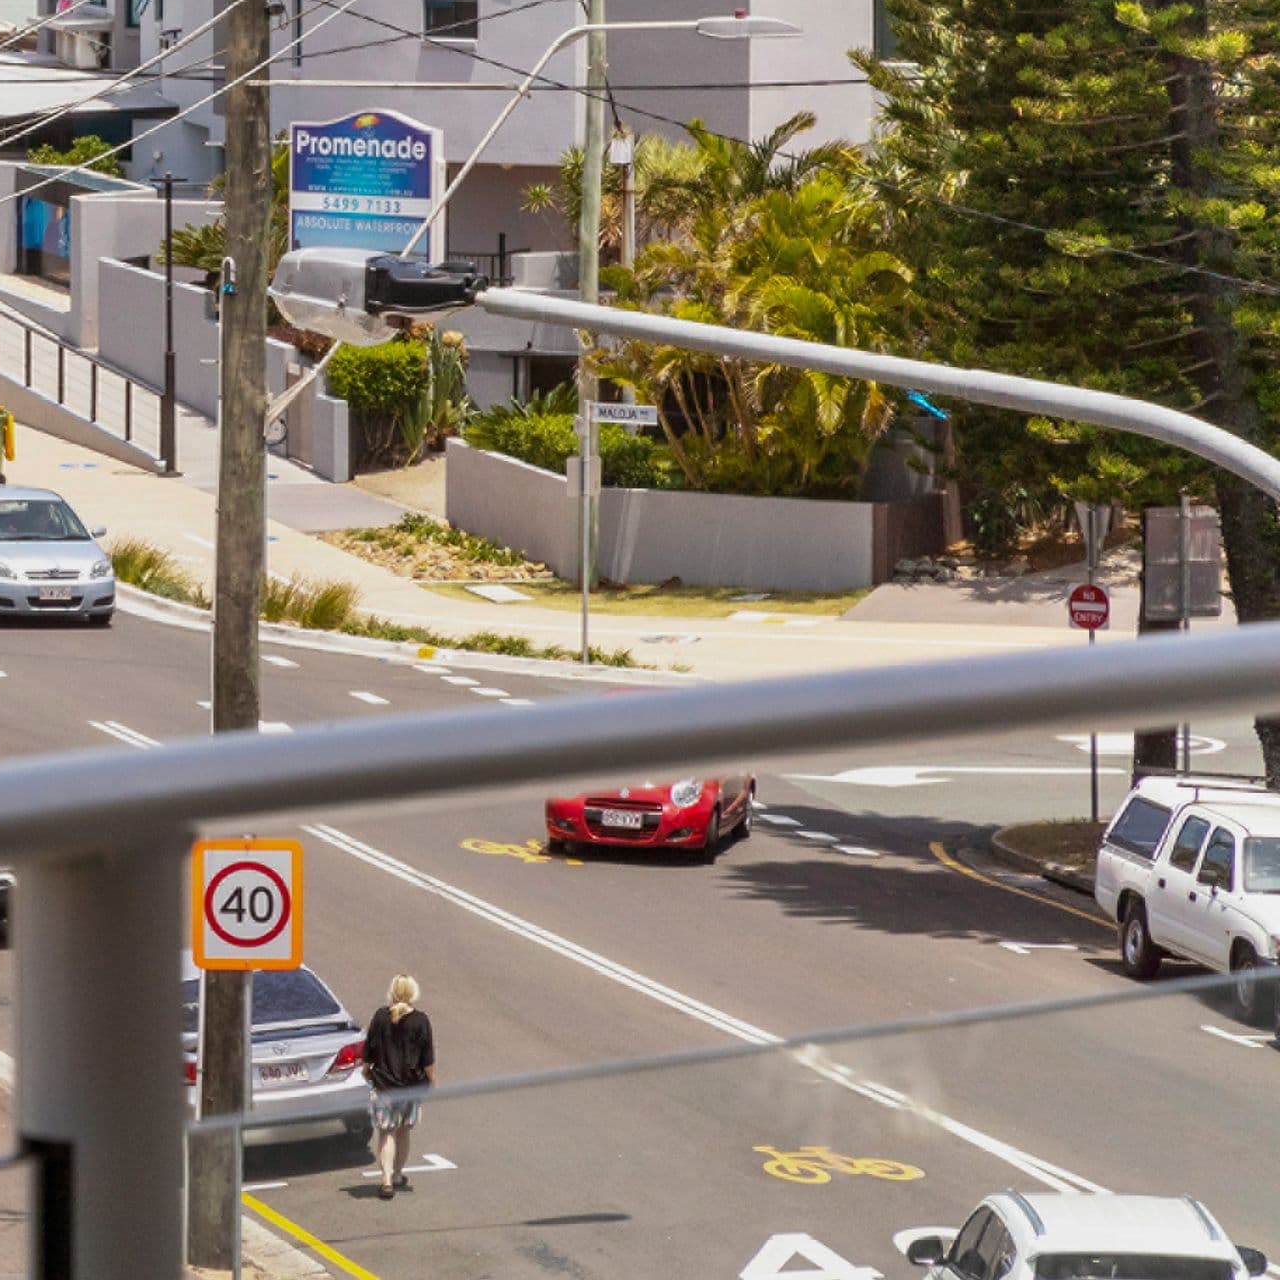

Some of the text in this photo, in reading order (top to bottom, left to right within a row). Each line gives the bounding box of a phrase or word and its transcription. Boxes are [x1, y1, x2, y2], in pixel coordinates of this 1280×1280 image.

[296, 129, 427, 160] Promenade
[322, 197, 401, 213] 5499 7133
[297, 215, 352, 230] ABSOLUTE
[1083, 591, 1096, 600] NO
[1074, 612, 1103, 623] ENTRY
[219, 885, 275, 924] 40
